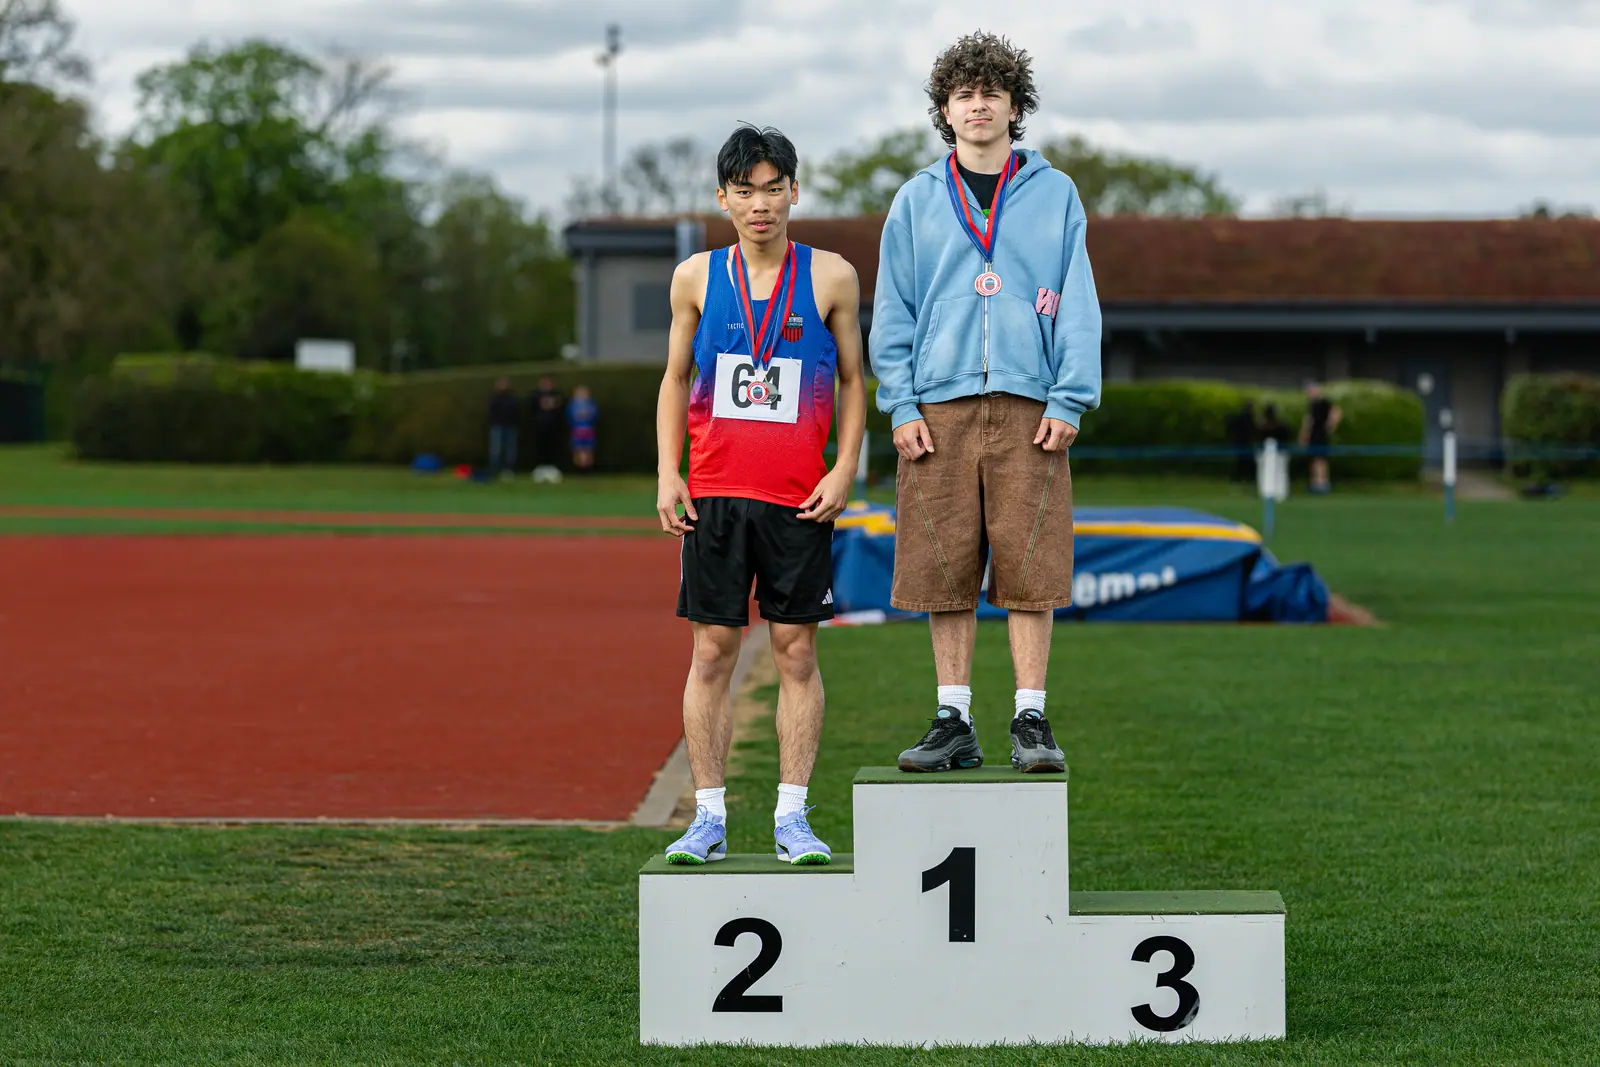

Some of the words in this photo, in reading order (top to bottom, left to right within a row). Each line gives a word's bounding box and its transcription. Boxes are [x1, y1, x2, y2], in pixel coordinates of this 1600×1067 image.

[732, 363, 781, 410] 64
[922, 847, 976, 943] 1
[712, 917, 783, 1013] 2
[1131, 935, 1200, 1032] 3
